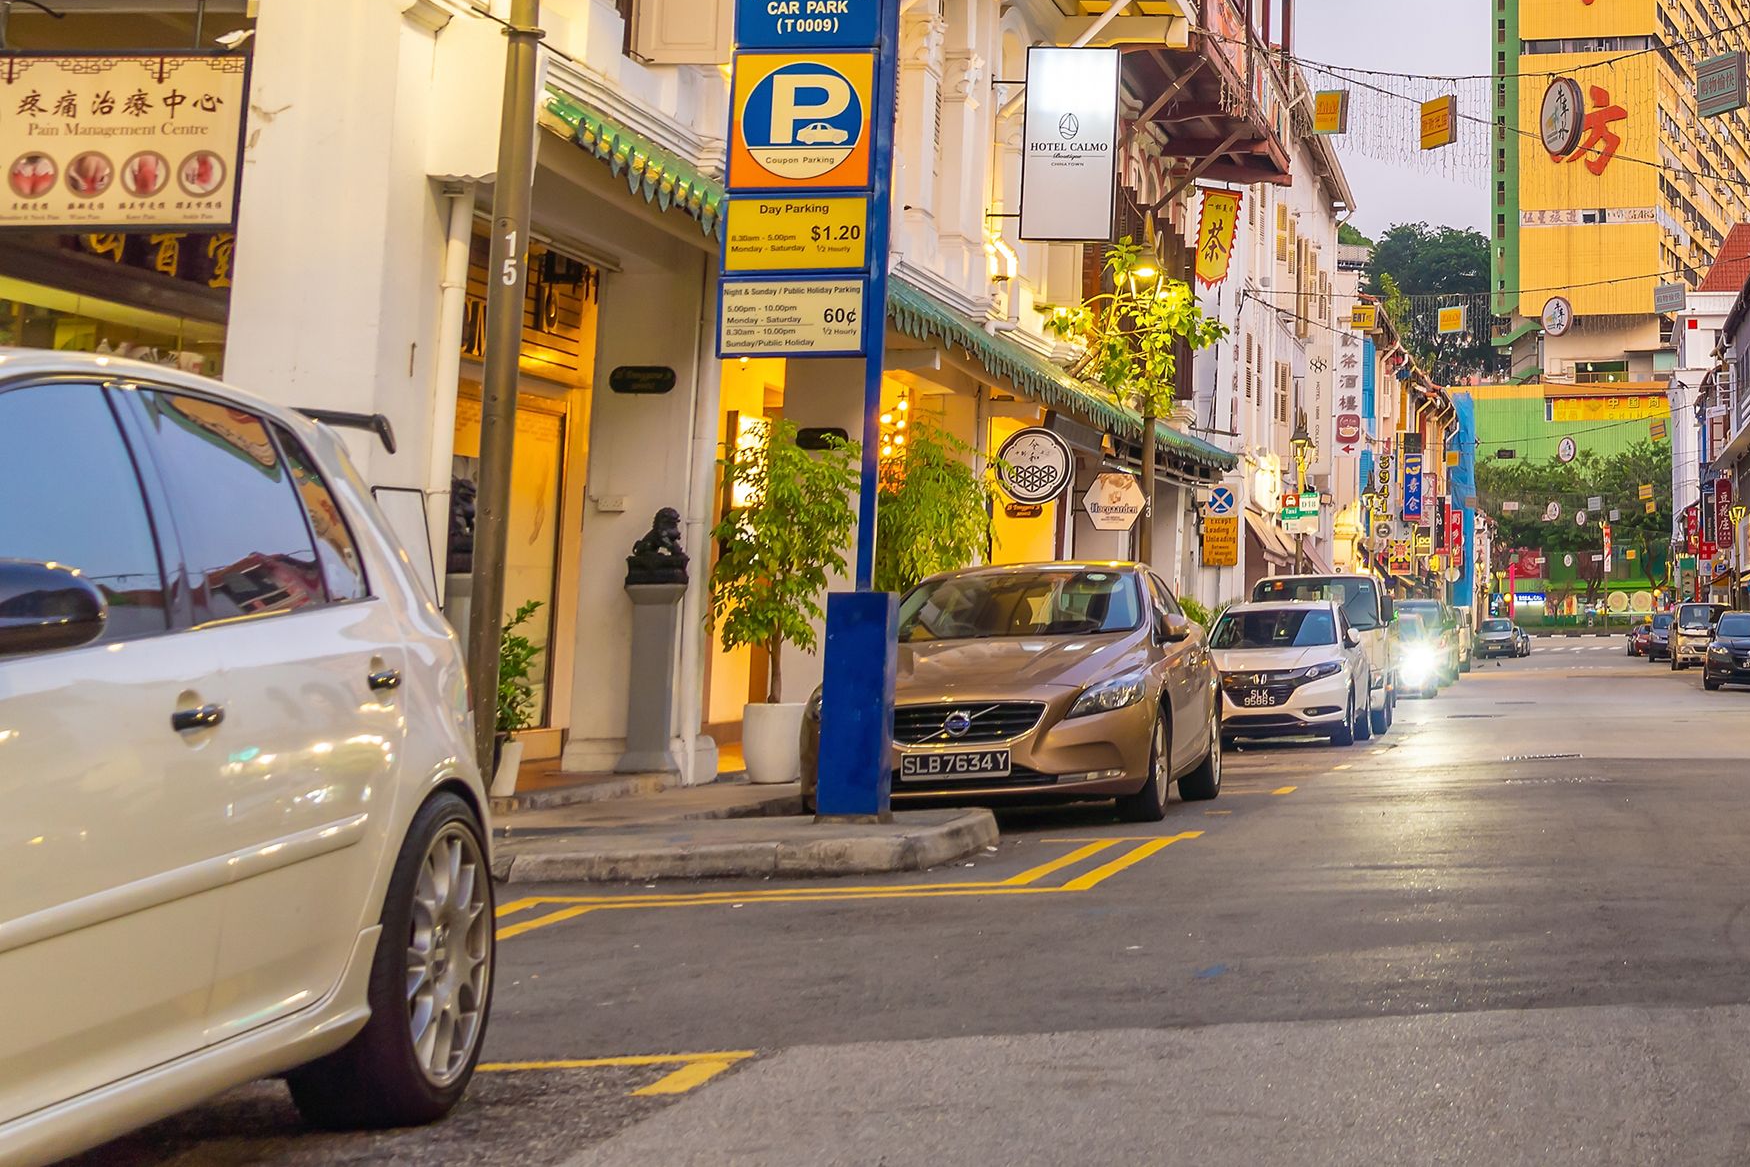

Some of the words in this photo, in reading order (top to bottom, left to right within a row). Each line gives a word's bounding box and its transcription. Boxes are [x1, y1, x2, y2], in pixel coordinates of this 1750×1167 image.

[767, 1, 800, 15] CAR
[806, 0, 849, 14] PARK
[777, 17, 840, 34] (T0009)
[16, 88, 224, 119] 疼痛治療中心
[769, 74, 851, 144] P
[28, 123, 59, 136] Pain
[64, 123, 156, 138] Management
[161, 122, 209, 135] Centre
[1030, 142, 1067, 151] HOTEL
[1070, 142, 1108, 151] CALMO
[765, 157, 799, 165] Coupon
[803, 156, 835, 165] Parking
[1053, 153, 1082, 161] Boutique
[759, 205, 782, 216] Day
[785, 204, 829, 214] Parking
[767, 234, 796, 242] 5.00pm
[811, 225, 861, 242] $1.20
[1201, 218, 1227, 263] 茶
[731, 245, 762, 253] Monday
[828, 245, 851, 253] Hourly
[751, 288, 777, 296] Sunday
[783, 287, 805, 295] Public
[807, 287, 832, 295] Holiday
[764, 305, 797, 313] 10.00pm
[727, 317, 758, 325] Monday
[766, 316, 802, 324] Saturday
[834, 328, 857, 336] Hourly
[725, 340, 783, 348] Sunday/Public
[785, 339, 815, 347] Holiday
[1091, 502, 1138, 514] Hoegaarden
[1250, 689, 1268, 699] SLK
